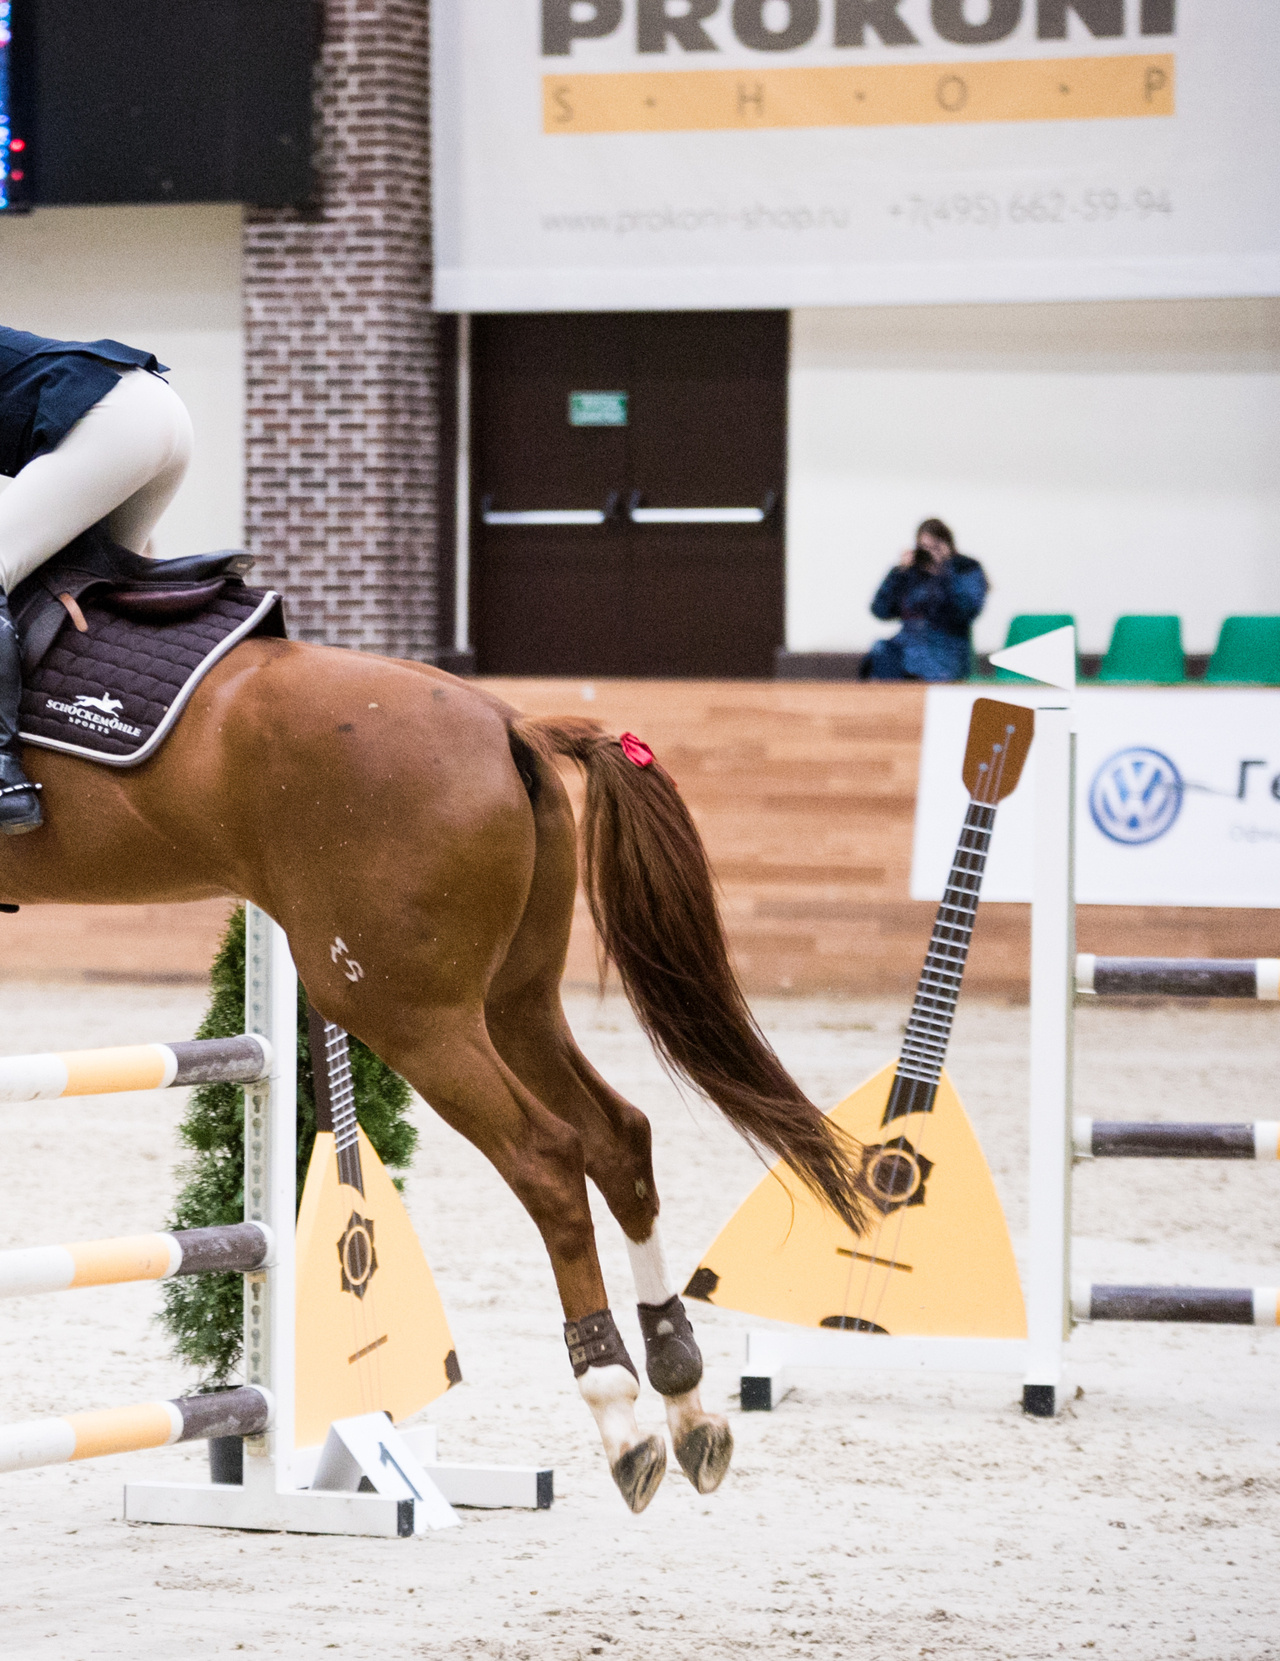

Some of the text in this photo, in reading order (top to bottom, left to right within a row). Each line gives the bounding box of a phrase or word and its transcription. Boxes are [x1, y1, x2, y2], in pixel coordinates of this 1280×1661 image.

[540, 0, 1176, 56] PROKONI
[68, 716, 110, 735] SPORTS
[378, 1441, 424, 1502] 1
